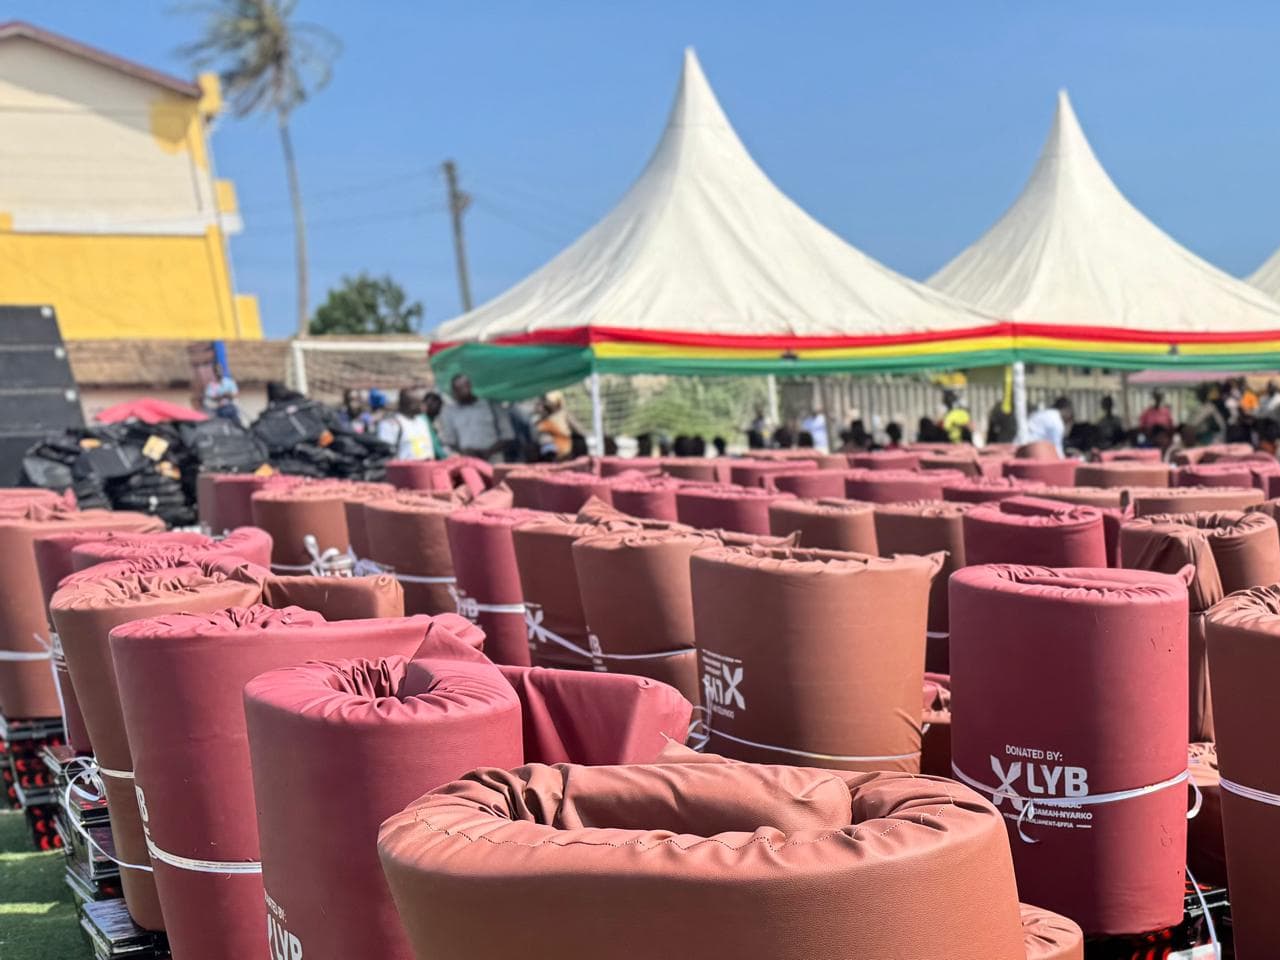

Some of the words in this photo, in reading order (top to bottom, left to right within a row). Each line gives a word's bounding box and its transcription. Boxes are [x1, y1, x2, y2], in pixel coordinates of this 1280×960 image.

[1005, 744, 1044, 760] DONATED
[1046, 751, 1063, 761] BY:
[1026, 761, 1089, 797] LYB
